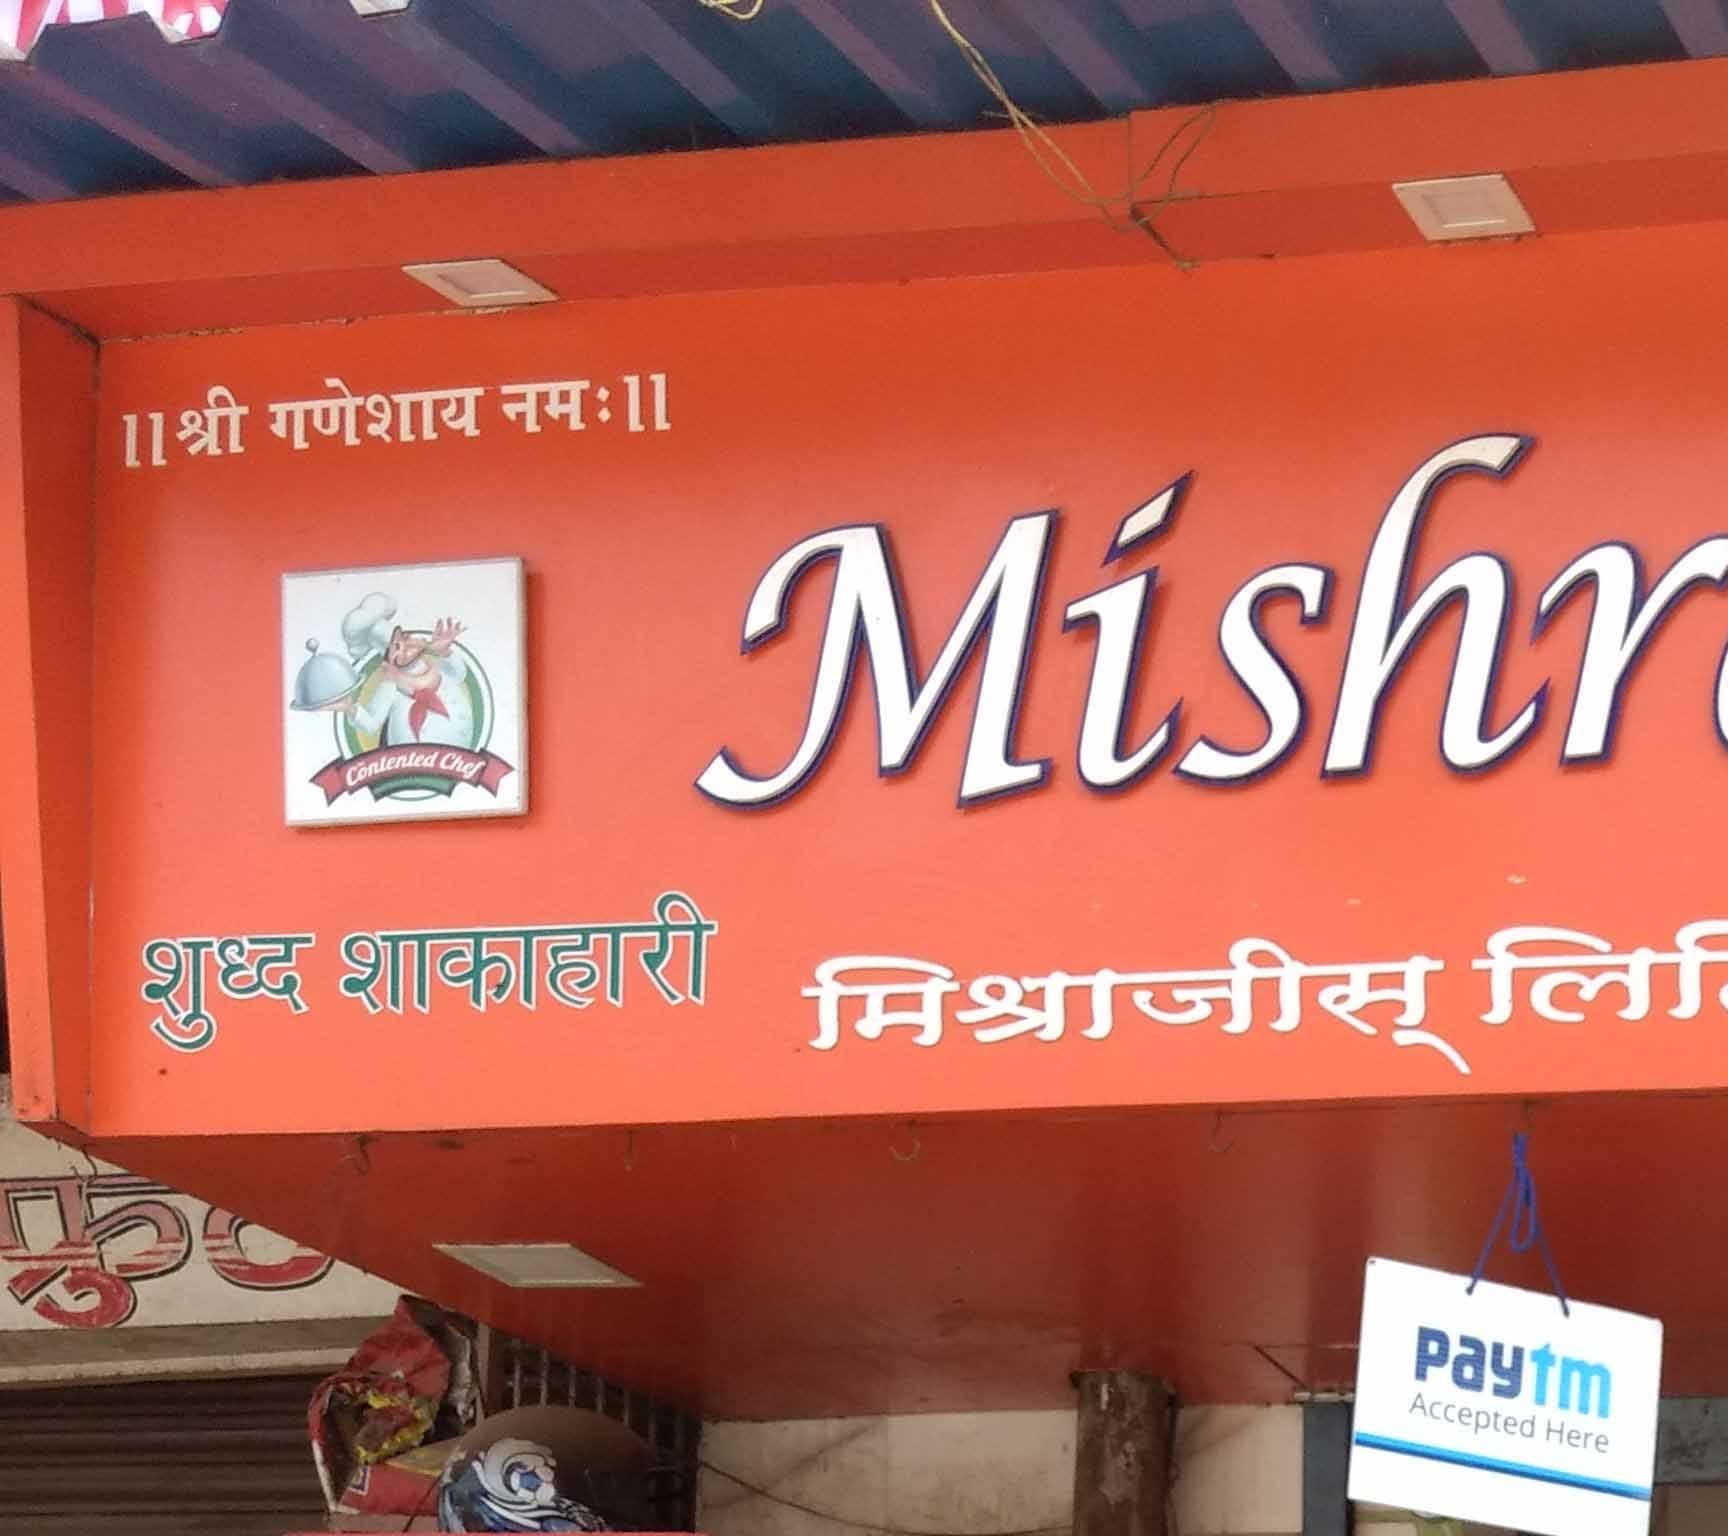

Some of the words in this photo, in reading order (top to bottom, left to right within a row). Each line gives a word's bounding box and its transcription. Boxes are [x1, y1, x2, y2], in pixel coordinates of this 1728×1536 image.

[269, 378, 484, 450] गणेशाय
[346, 751, 439, 786] Contented
[440, 752, 488, 778] Chef
[341, 891, 719, 1013] शाकाहारी
[802, 937, 1471, 1075] मिश्राजीस्
[1409, 1393, 1535, 1438] Accepted
[1546, 1420, 1610, 1454] Here
